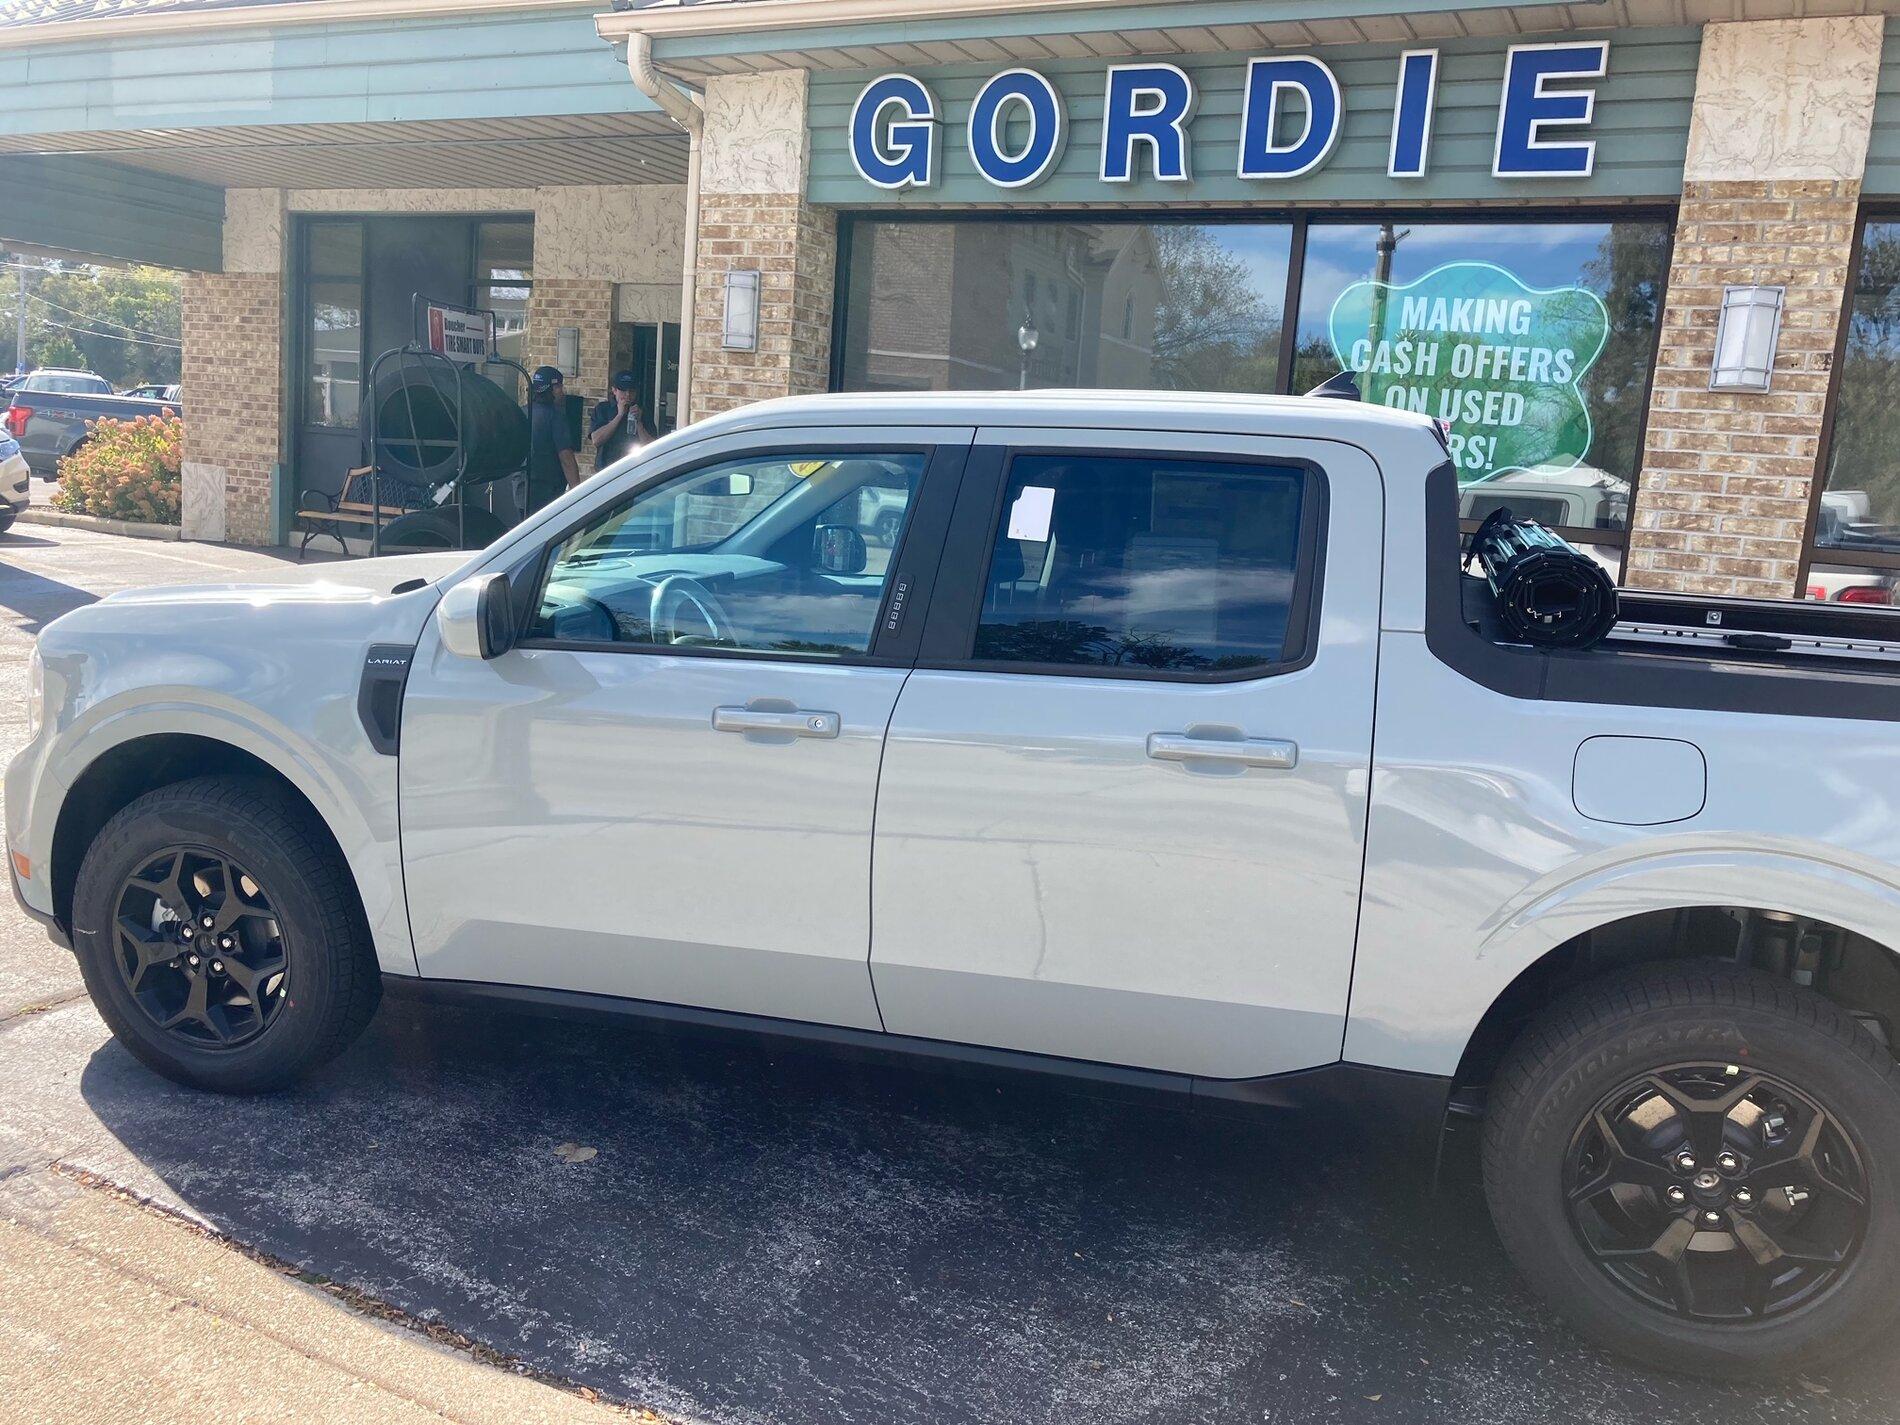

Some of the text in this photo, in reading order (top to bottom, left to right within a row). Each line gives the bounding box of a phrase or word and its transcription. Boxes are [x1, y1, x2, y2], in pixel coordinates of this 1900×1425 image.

[848, 40, 1610, 190] GORDIE
[1400, 296, 1532, 335] MAKING
[1451, 344, 1575, 384] OFFERS
[1385, 385, 1525, 426] ON USED
[1449, 433, 1497, 470] RS!
